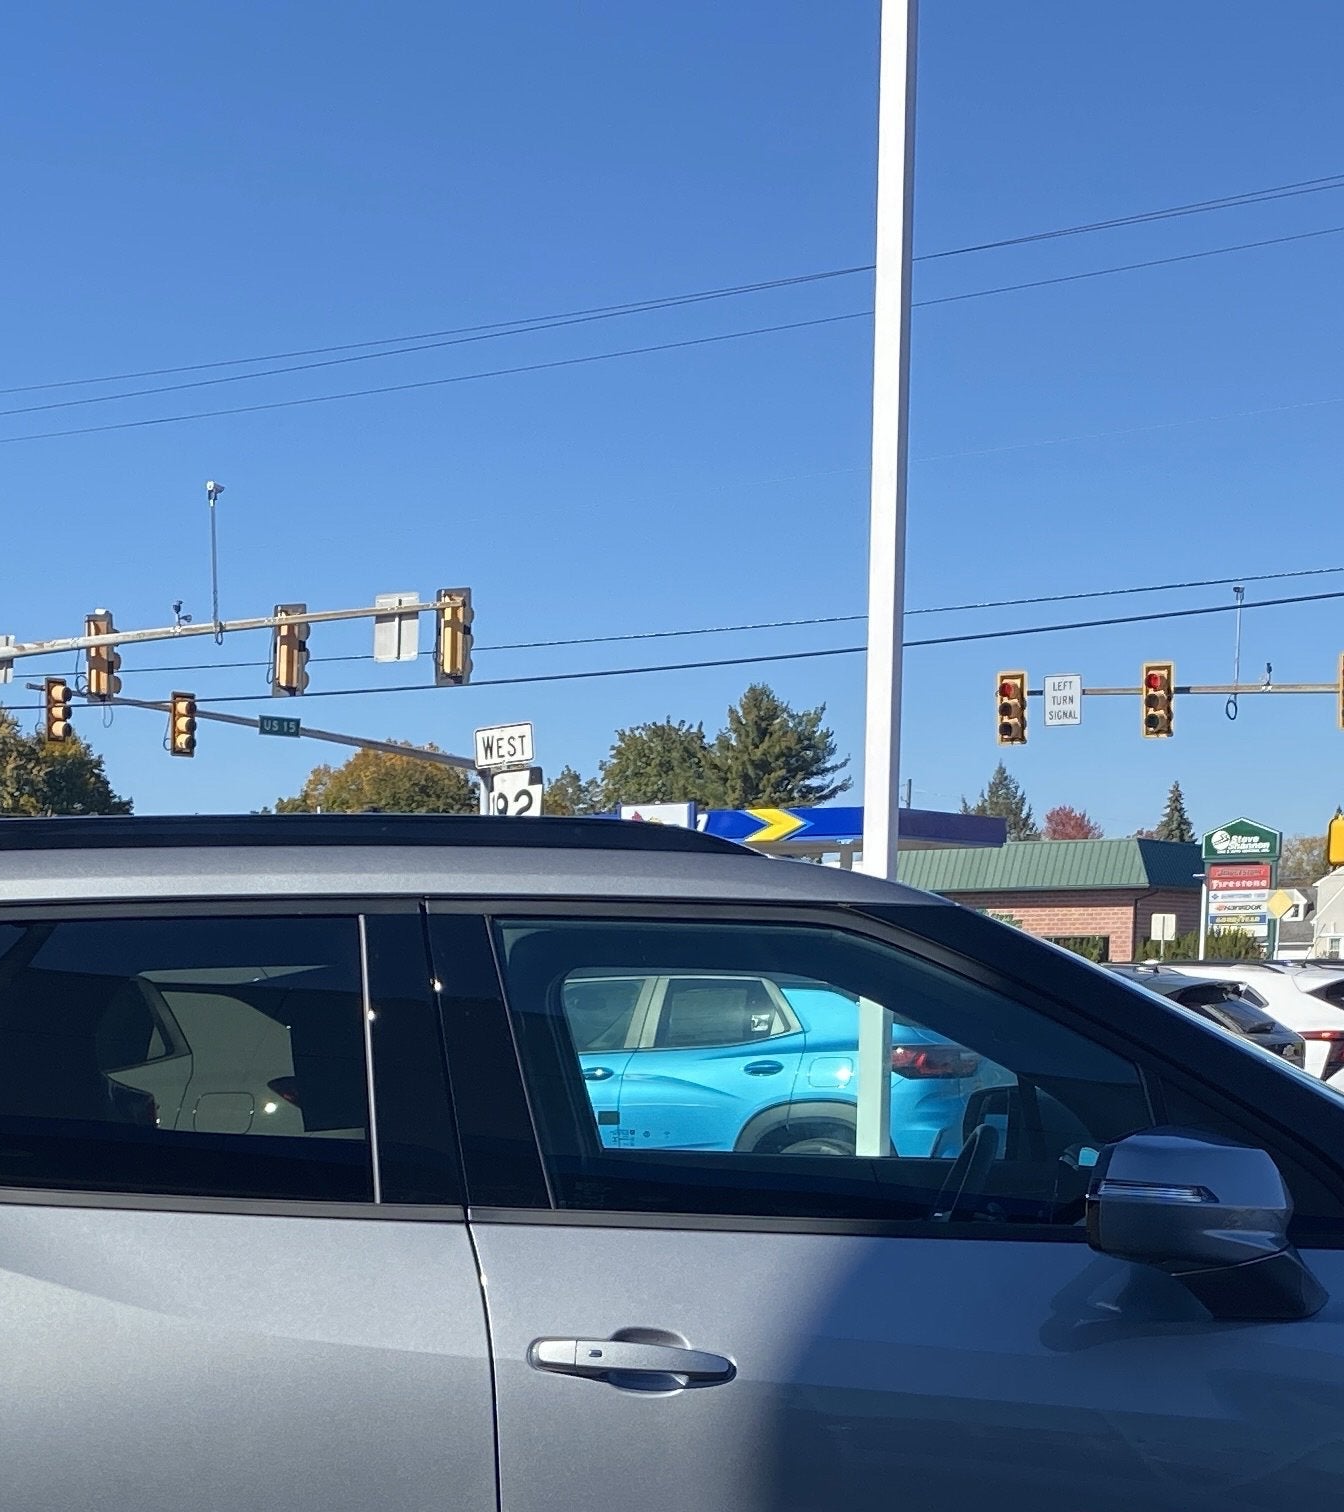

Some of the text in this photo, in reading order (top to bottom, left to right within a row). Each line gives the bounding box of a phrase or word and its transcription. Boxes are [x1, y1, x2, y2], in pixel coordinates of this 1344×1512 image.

[1052, 680, 1073, 692] LEFT
[1052, 694, 1074, 706] TURN
[1048, 709, 1078, 721] SIGNAL
[264, 719, 296, 733] US 15
[482, 735, 526, 760] WEST
